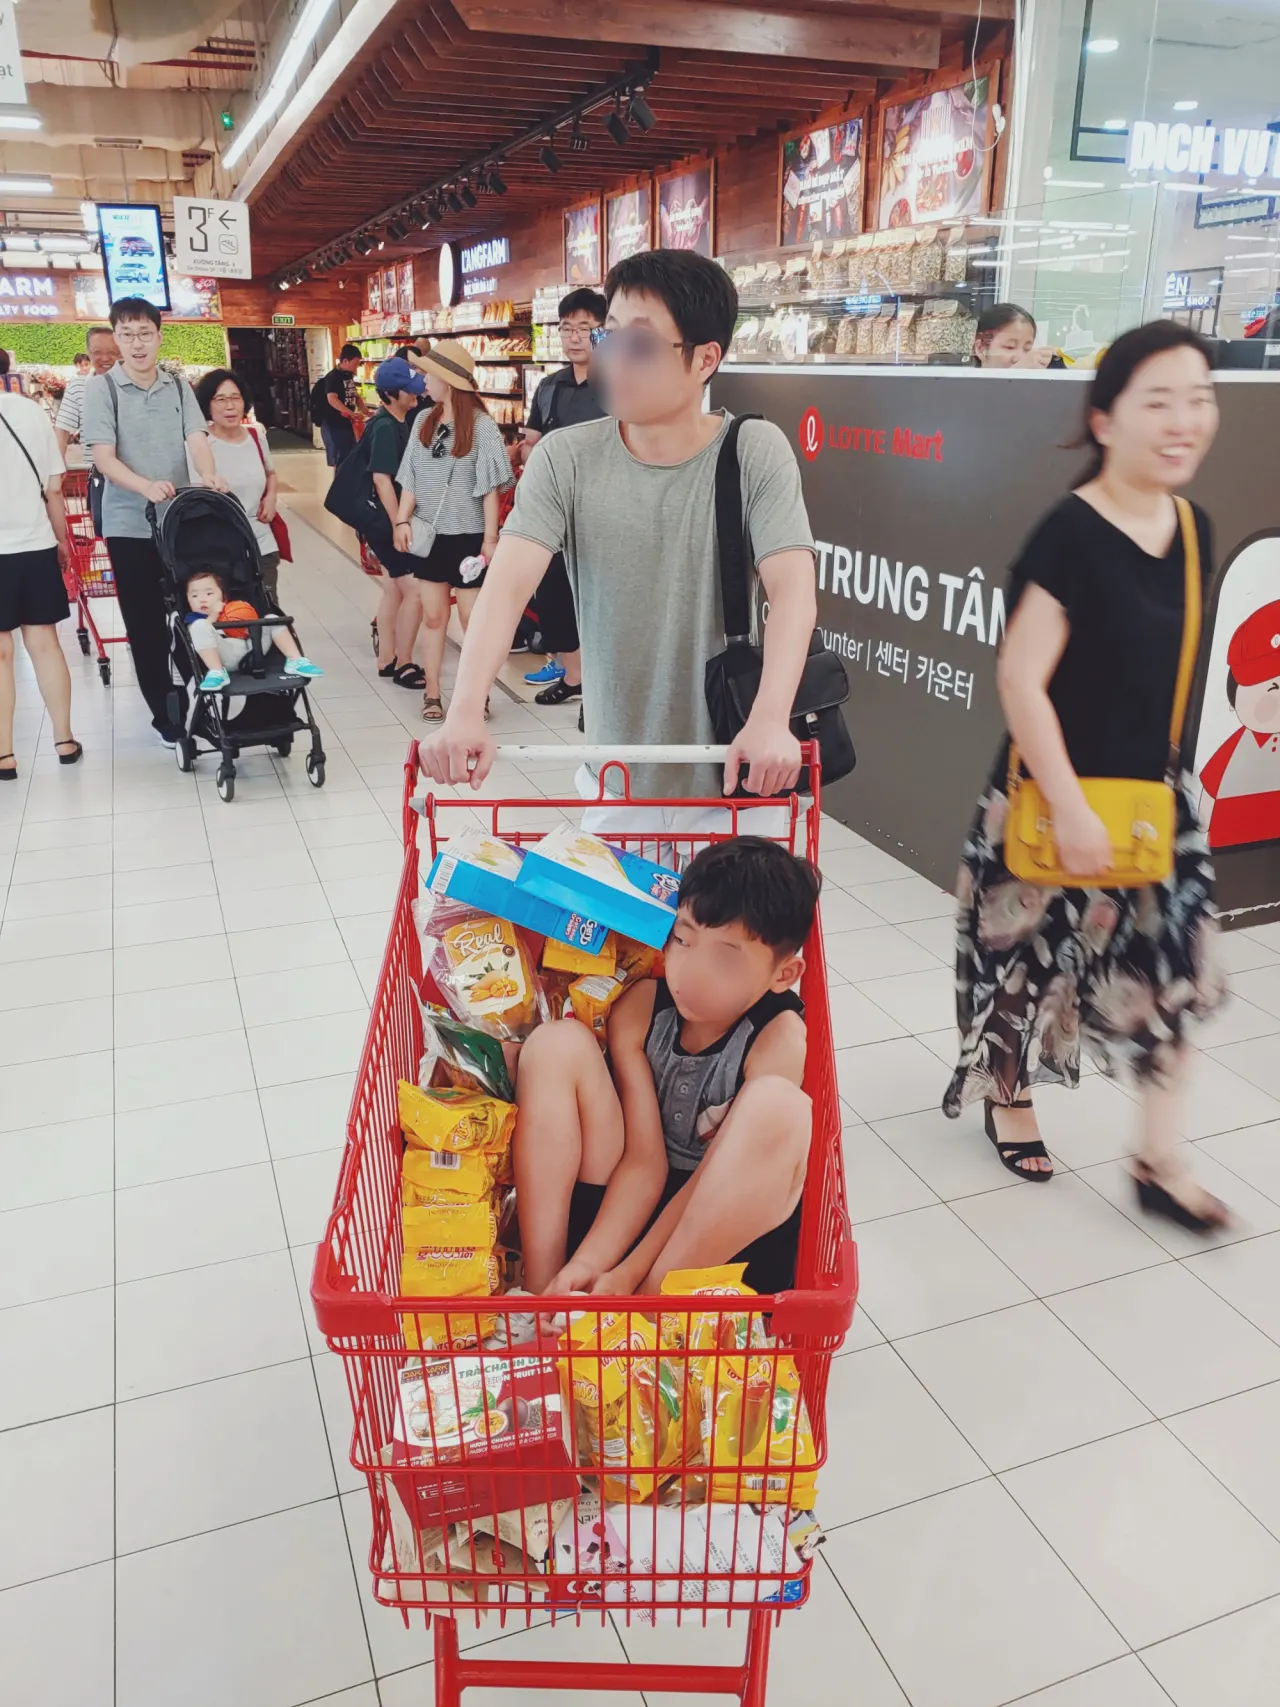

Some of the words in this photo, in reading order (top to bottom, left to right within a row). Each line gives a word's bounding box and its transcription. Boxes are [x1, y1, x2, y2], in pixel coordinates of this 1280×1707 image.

[829, 424, 885, 454] LOTTE
[891, 425, 944, 462] Mart
[815, 540, 929, 621] TRUNG
[816, 627, 863, 662] unter
[875, 639, 909, 684] 센터
[915, 655, 974, 710] 카운터
[453, 923, 504, 957] Real
[580, 919, 598, 946] Gery
